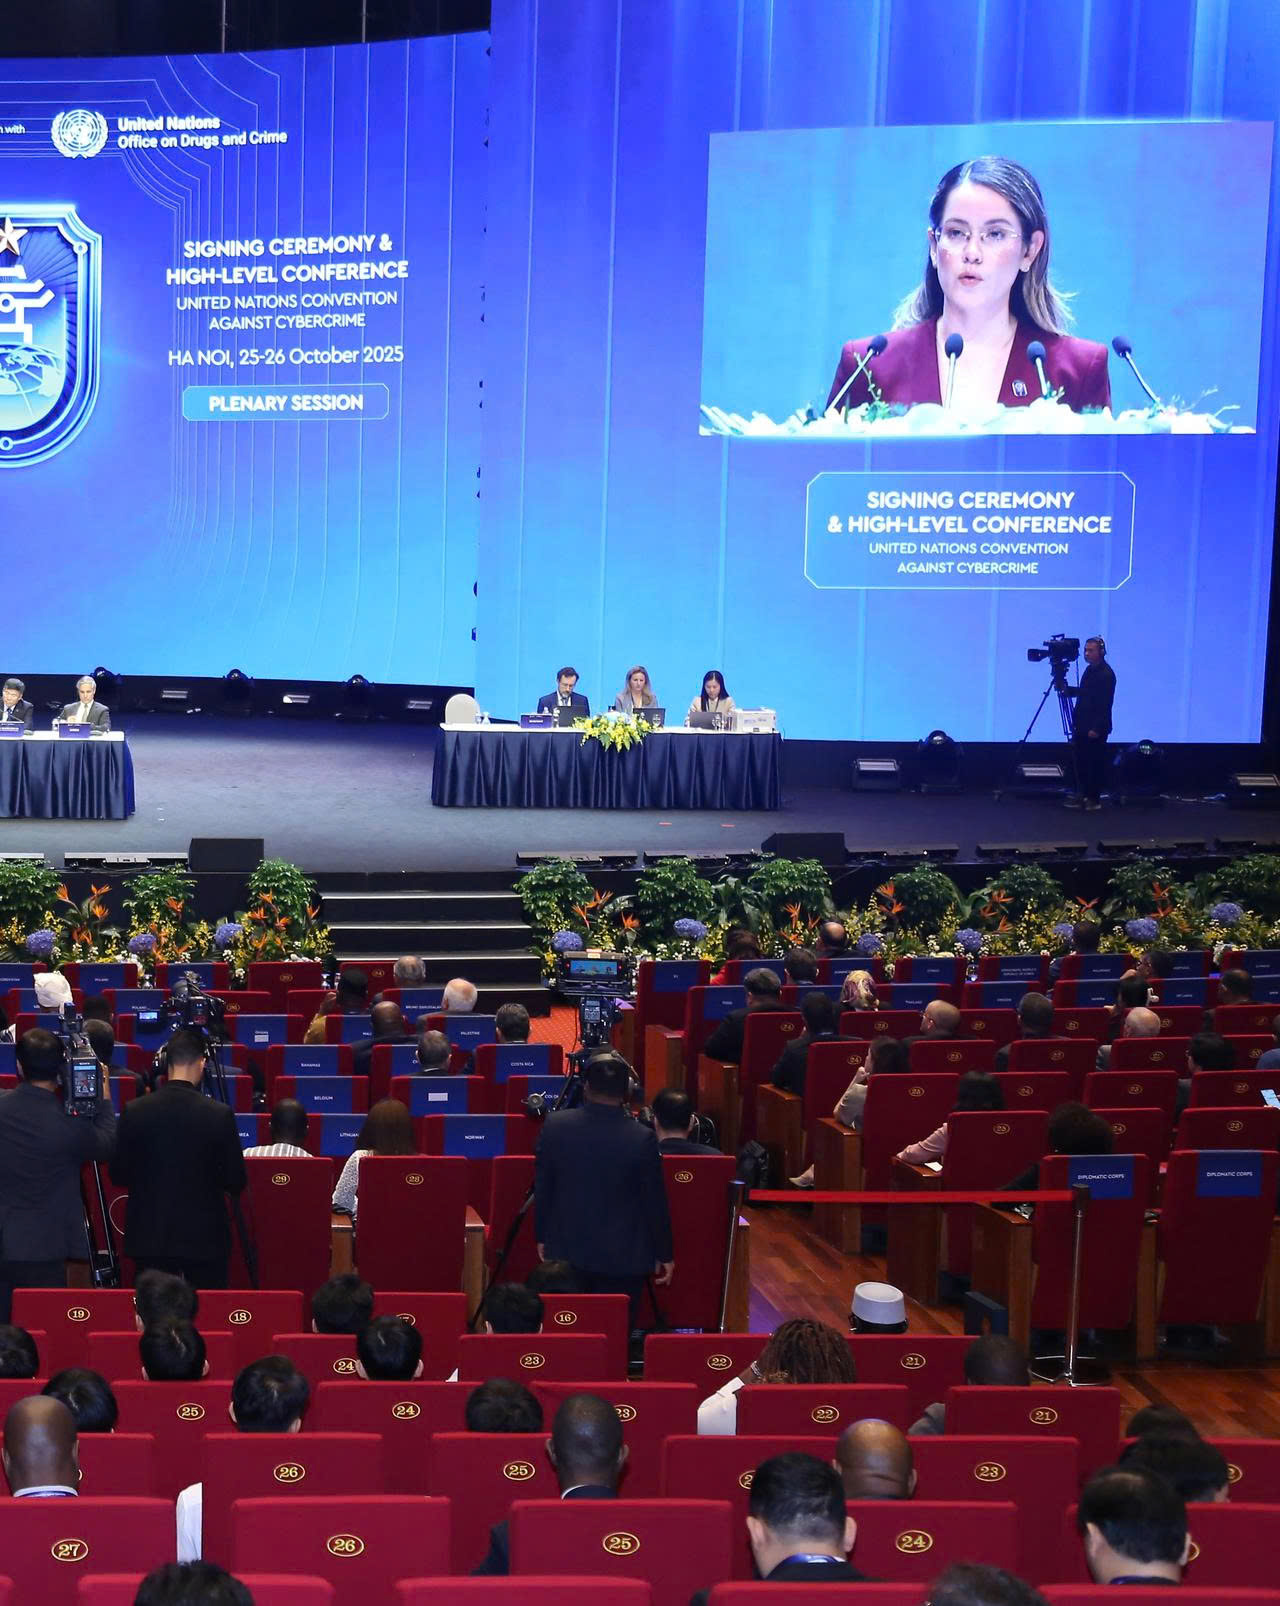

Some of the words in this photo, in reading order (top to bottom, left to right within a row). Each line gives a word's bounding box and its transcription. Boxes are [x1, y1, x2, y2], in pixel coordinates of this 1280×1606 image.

[4, 124, 26, 134] with
[118, 116, 163, 131] United
[166, 115, 220, 131] Nations
[118, 135, 158, 149] Office
[161, 137, 177, 148] on
[180, 133, 219, 149] Drugs
[222, 132, 246, 146] and
[249, 130, 288, 145] Crime
[183, 239, 265, 258] SIGNING
[269, 235, 376, 256] CEREMONY
[379, 233, 393, 252] &
[166, 266, 278, 285] HIGH-LEVEL
[281, 260, 409, 283] CONFERENCE
[176, 296, 231, 311] UNITED
[234, 294, 297, 309] NATIONS
[301, 291, 398, 308] CONVENTION
[209, 315, 272, 330] AGAINST
[275, 313, 366, 329] CYBERCRIME
[168, 350, 194, 366] HA
[198, 349, 234, 368] NOI,
[239, 348, 285, 365] 25-26
[289, 346, 360, 365] October
[363, 345, 404, 363] 2025
[209, 395, 288, 412] PLENARY
[291, 394, 363, 411] SESSION
[867, 491, 953, 509] SIGNING
[959, 491, 1075, 509] CEREMONY
[827, 515, 842, 533] &
[848, 516, 967, 533] HIGH-LEVEL
[972, 516, 1111, 533] CONFERENCE
[869, 543, 917, 554] UNITED
[920, 542, 977, 554] NATIONS
[980, 542, 1069, 554] CONVENTION
[897, 562, 954, 574] AGAINST
[957, 562, 1038, 574] CYBERCRIME
[72, 1310, 86, 1319] 19
[233, 1312, 247, 1322] 18
[559, 1314, 572, 1323] 16
[338, 1361, 354, 1371] 24
[524, 1355, 540, 1365] 23
[711, 1357, 728, 1368] 22
[905, 1357, 920, 1367] 21
[181, 1406, 199, 1417] 25
[396, 1405, 415, 1416] 24
[816, 1409, 834, 1420] 22
[1035, 1410, 1051, 1421] 21
[279, 1466, 298, 1479] 26
[509, 1465, 528, 1477] 25
[979, 1466, 999, 1477] 23
[333, 1539, 355, 1552] 26
[609, 1536, 632, 1550] 25
[903, 1535, 925, 1548] 24
[58, 1544, 80, 1557] 27
